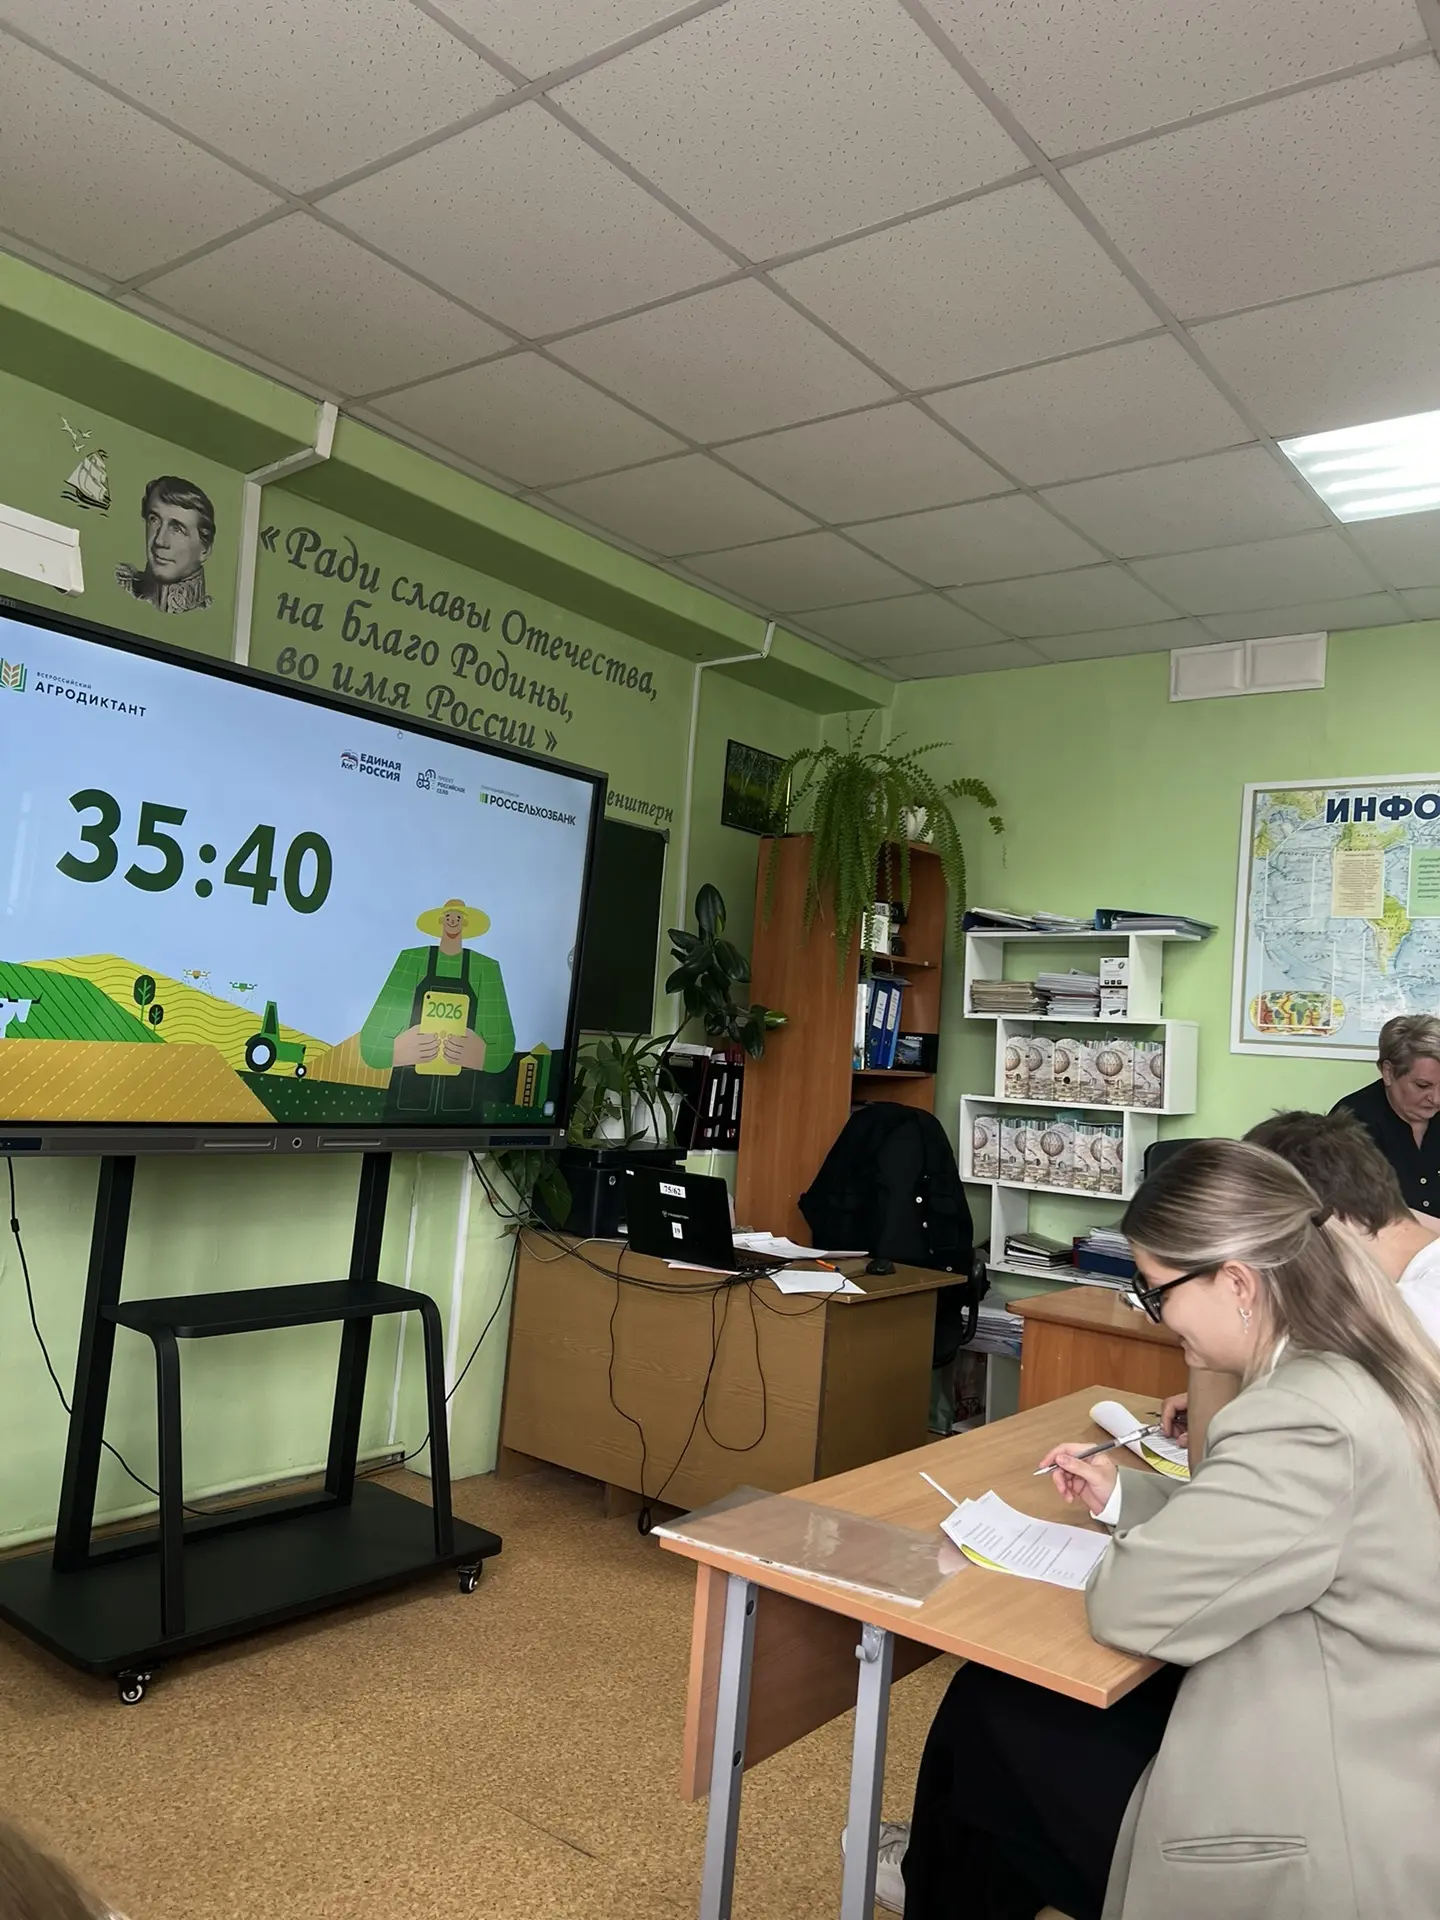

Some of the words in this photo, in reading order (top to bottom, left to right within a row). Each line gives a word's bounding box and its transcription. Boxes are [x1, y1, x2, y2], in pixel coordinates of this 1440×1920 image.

[391, 576, 491, 632] славы
[502, 609, 658, 702] Отечества,
[277, 592, 324, 631] на
[451, 643, 573, 724] Родины,
[276, 647, 319, 681] во
[332, 662, 411, 710] имя
[35, 681, 147, 717] АГРОДИКТАНТ
[359, 763, 401, 782] РОССИЯ
[360, 752, 402, 771] ЕДИНАЯ
[489, 794, 576, 826] РОССЕЛЬХОЗБАНК
[1325, 794, 1440, 824] ИНФО
[55, 788, 333, 914] 35:40
[426, 1001, 463, 1020] 2026
